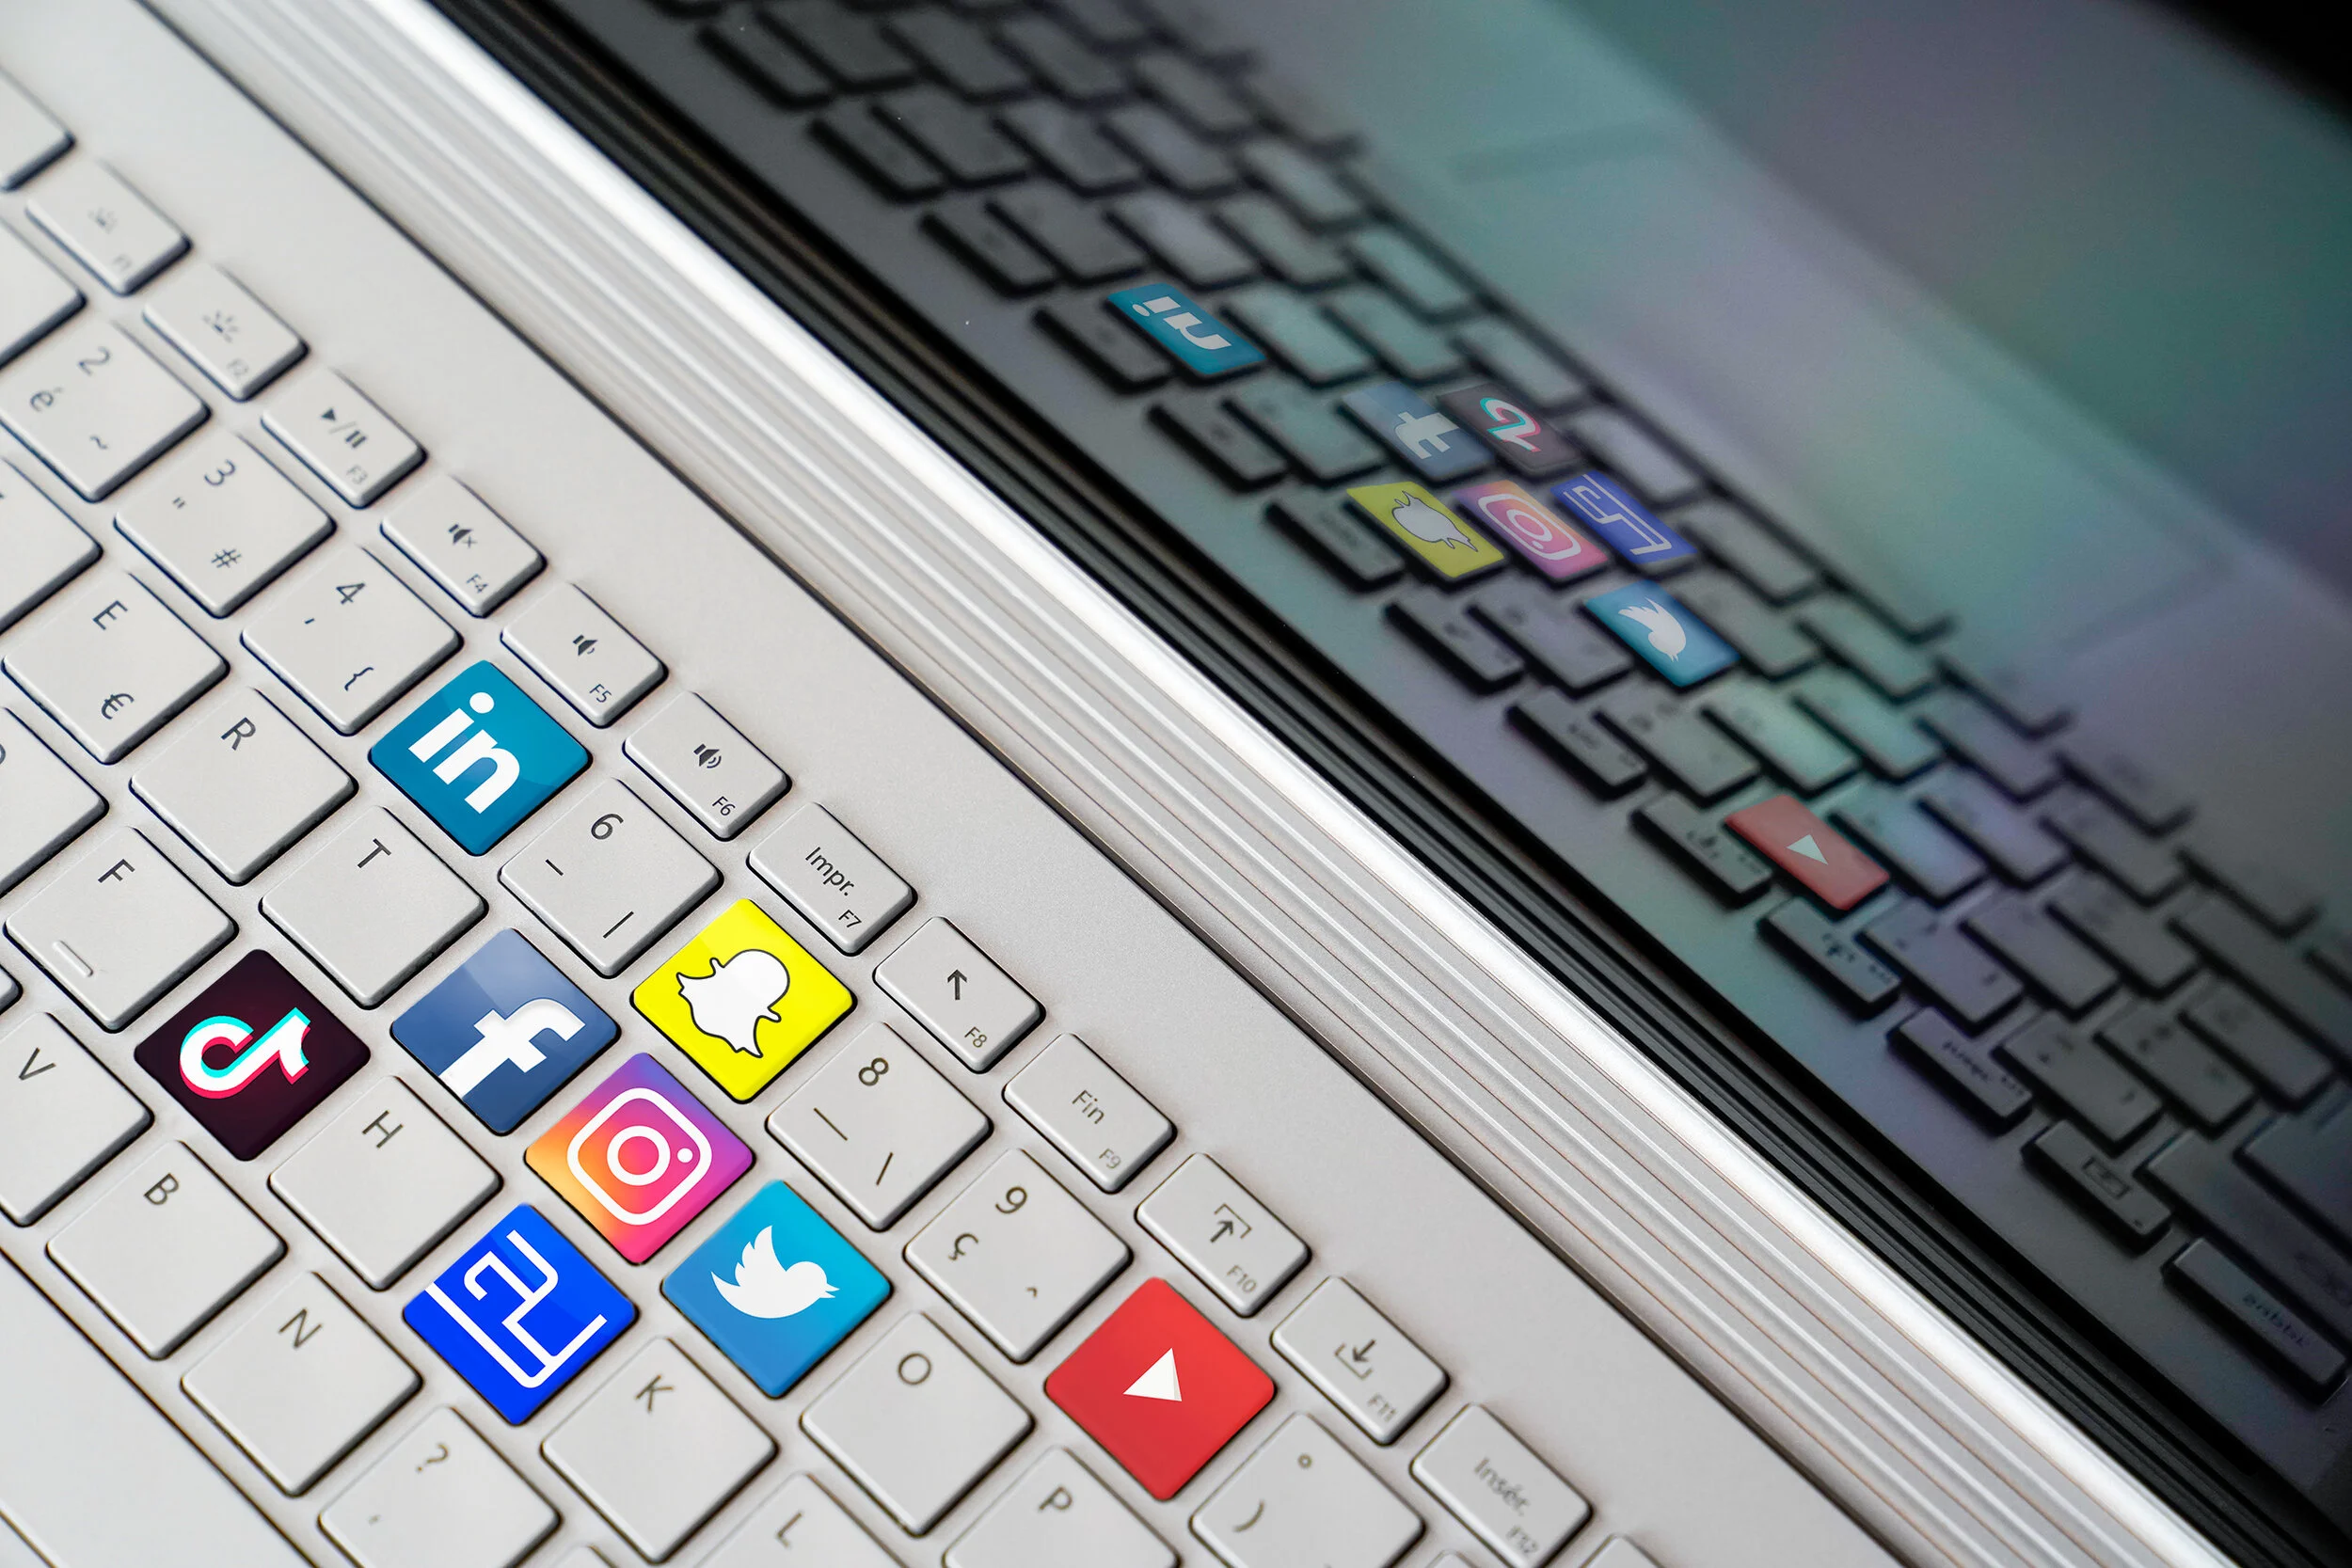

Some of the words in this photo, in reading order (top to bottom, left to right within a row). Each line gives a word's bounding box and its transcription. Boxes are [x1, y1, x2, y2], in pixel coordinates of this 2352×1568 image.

[78, 347, 111, 374] 2
[203, 461, 236, 486] 3
[346, 465, 369, 484] F3
[335, 582, 366, 605] 4
[467, 574, 488, 594] F4
[92, 600, 128, 630] E
[101, 692, 135, 721] €
[589, 683, 612, 705] F5
[220, 717, 256, 751] R
[408, 691, 520, 814] in
[711, 796, 736, 816] F6
[590, 813, 624, 840] 6
[357, 838, 391, 869] T
[97, 858, 135, 883] F
[805, 847, 854, 896] Impr.
[838, 909, 862, 928] F7
[964, 1026, 988, 1048] F8
[18, 1047, 56, 1081] V
[858, 1057, 889, 1086] 8
[1072, 1089, 1104, 1124] Fin
[361, 1110, 404, 1148] H
[1098, 1148, 1121, 1169] F9
[143, 1173, 180, 1206] B
[994, 1186, 1028, 1214] 9
[1227, 1264, 1257, 1292] F10
[278, 1308, 322, 1349] N
[635, 1374, 673, 1412] K
[1368, 1394, 1396, 1421] F11
[416, 1443, 450, 1474] ?
[1039, 1486, 1073, 1512] P
[776, 1512, 803, 1546] L
